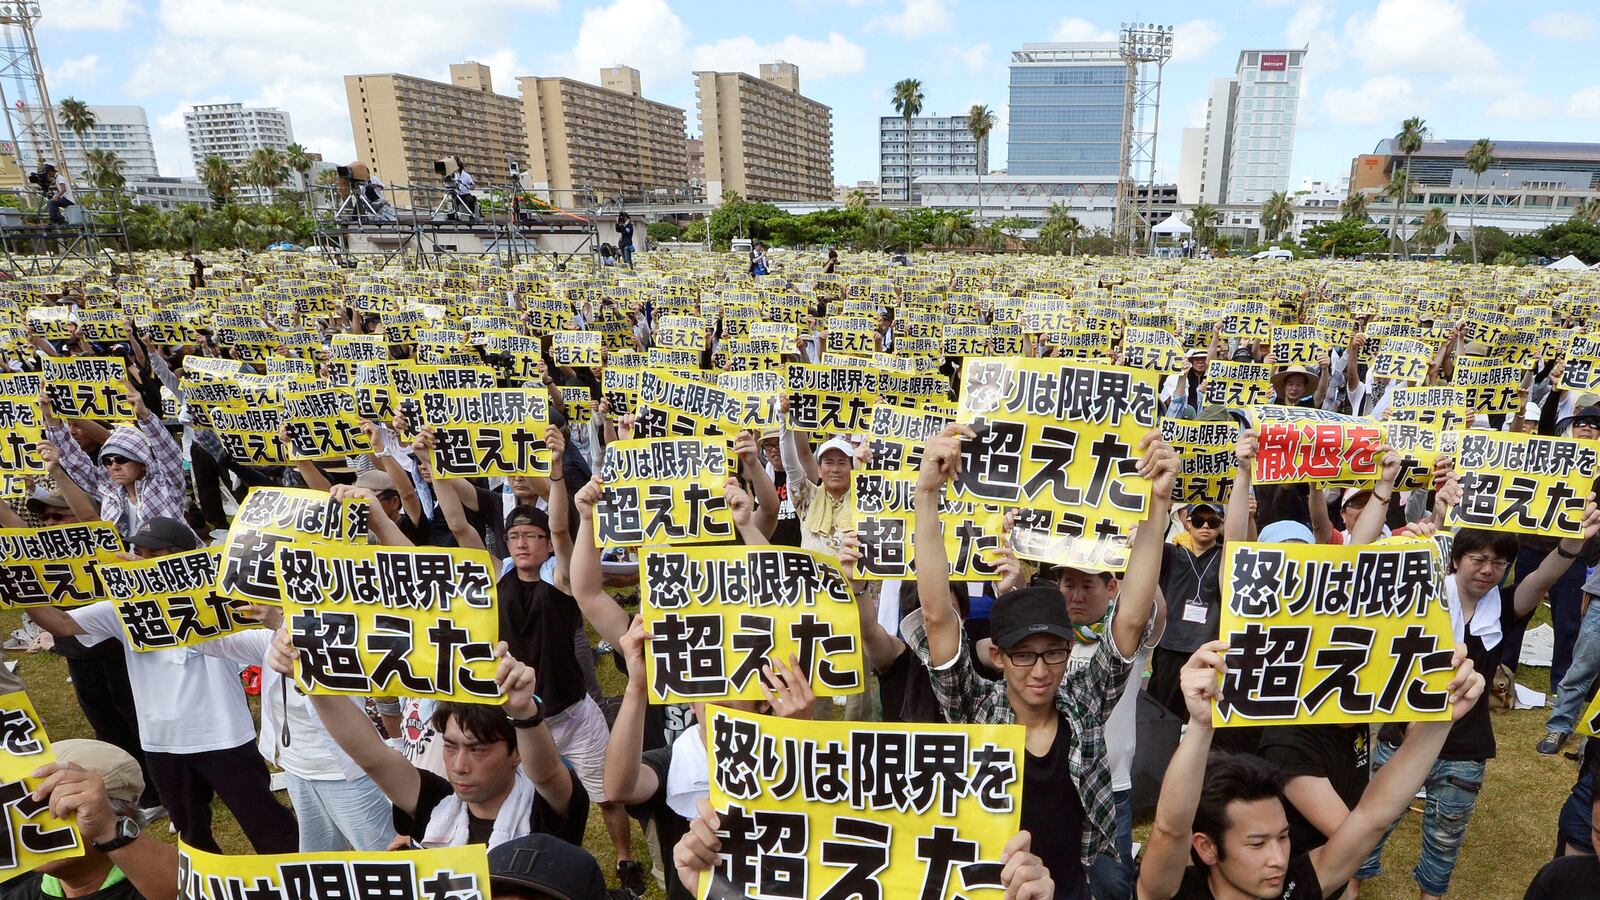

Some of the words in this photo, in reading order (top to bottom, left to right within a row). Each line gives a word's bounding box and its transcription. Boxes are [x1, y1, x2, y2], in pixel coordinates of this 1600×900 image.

[481, 276, 508, 287] 超えた
[516, 282, 545, 293] 超えた
[295, 299, 335, 313] 超えた
[356, 296, 393, 311] 超えた
[527, 297, 569, 312] 怒りは限界を
[769, 293, 807, 306] 怒りは限界を
[1025, 300, 1073, 312] 怒りは限界を
[1418, 301, 1448, 312] 超えた
[77, 310, 121, 322] 怒りは限界を
[381, 312, 426, 325] 怒りは限界を
[769, 307, 807, 324] 超えた
[946, 303, 977, 317] 超えた
[1129, 312, 1175, 326] 怒りは限界を
[1467, 307, 1512, 326] 怒りは限界を
[29, 320, 69, 334] 超えた
[471, 316, 515, 330] 怒りは限界を
[528, 312, 568, 330] 超えた
[660, 317, 705, 329] 怒りは限界を
[751, 322, 797, 334] 怒りは限界を
[829, 318, 875, 331] 怒りは限界を
[1025, 312, 1073, 331] 超えた
[1222, 315, 1269, 335] 超えた
[1367, 322, 1418, 337] 怒りは限界を
[82, 323, 127, 341] 超えた
[149, 324, 198, 342] 超えた
[417, 331, 465, 343] 怒りは限界を
[554, 332, 600, 344] 怒りは限界を
[658, 328, 704, 348] 超えた
[908, 324, 941, 338] 超えた
[1060, 333, 1109, 347] 怒りは限界を
[729, 340, 779, 355] 怒りは限界を
[827, 332, 873, 350] 超えた
[895, 338, 939, 351] 怒りは限界を
[943, 338, 984, 355] 超えた
[1381, 338, 1431, 357] 怒りは限界を
[555, 346, 600, 365] 超えた
[649, 349, 698, 365] 怒りは限界を
[1124, 345, 1183, 372] 超えた
[43, 360, 124, 382] 怒りは限界を
[1209, 362, 1270, 382] 怒りは限界を
[1374, 353, 1425, 379] 超えた
[788, 365, 877, 393] 怒りは限界を
[878, 374, 944, 396] 怒りは限界を
[1457, 366, 1522, 386] 怒りは限界を
[46, 383, 134, 417] 超えた
[640, 370, 742, 423] 怒りは限界を
[965, 360, 1157, 428] 怒りは限界を
[1206, 381, 1267, 406] 超えた
[1393, 388, 1465, 408] 怒りは限界を
[423, 391, 546, 425] 怒りは限界を
[787, 392, 873, 431] 超えた
[286, 420, 371, 457] 超えた
[1161, 419, 1240, 446] 怒りは限界を
[432, 427, 552, 478] 超えた
[1255, 422, 1383, 482] 撤退を
[1458, 433, 1597, 477] 怒りは限界を
[600, 440, 726, 484] 怒りは限界を
[952, 416, 1145, 513] 超えた
[1450, 471, 1587, 533] 超えた
[597, 482, 731, 545] 超えた
[855, 516, 998, 576] 超た
[278, 547, 493, 611] 怒りは限界を
[645, 551, 852, 610] 怒りは限界を
[118, 590, 261, 650] 超えた
[291, 608, 501, 698] 超えた
[651, 612, 859, 701] 超えた
[1217, 623, 1455, 722] 超えた
[711, 710, 1017, 817] 怒りは限界を
